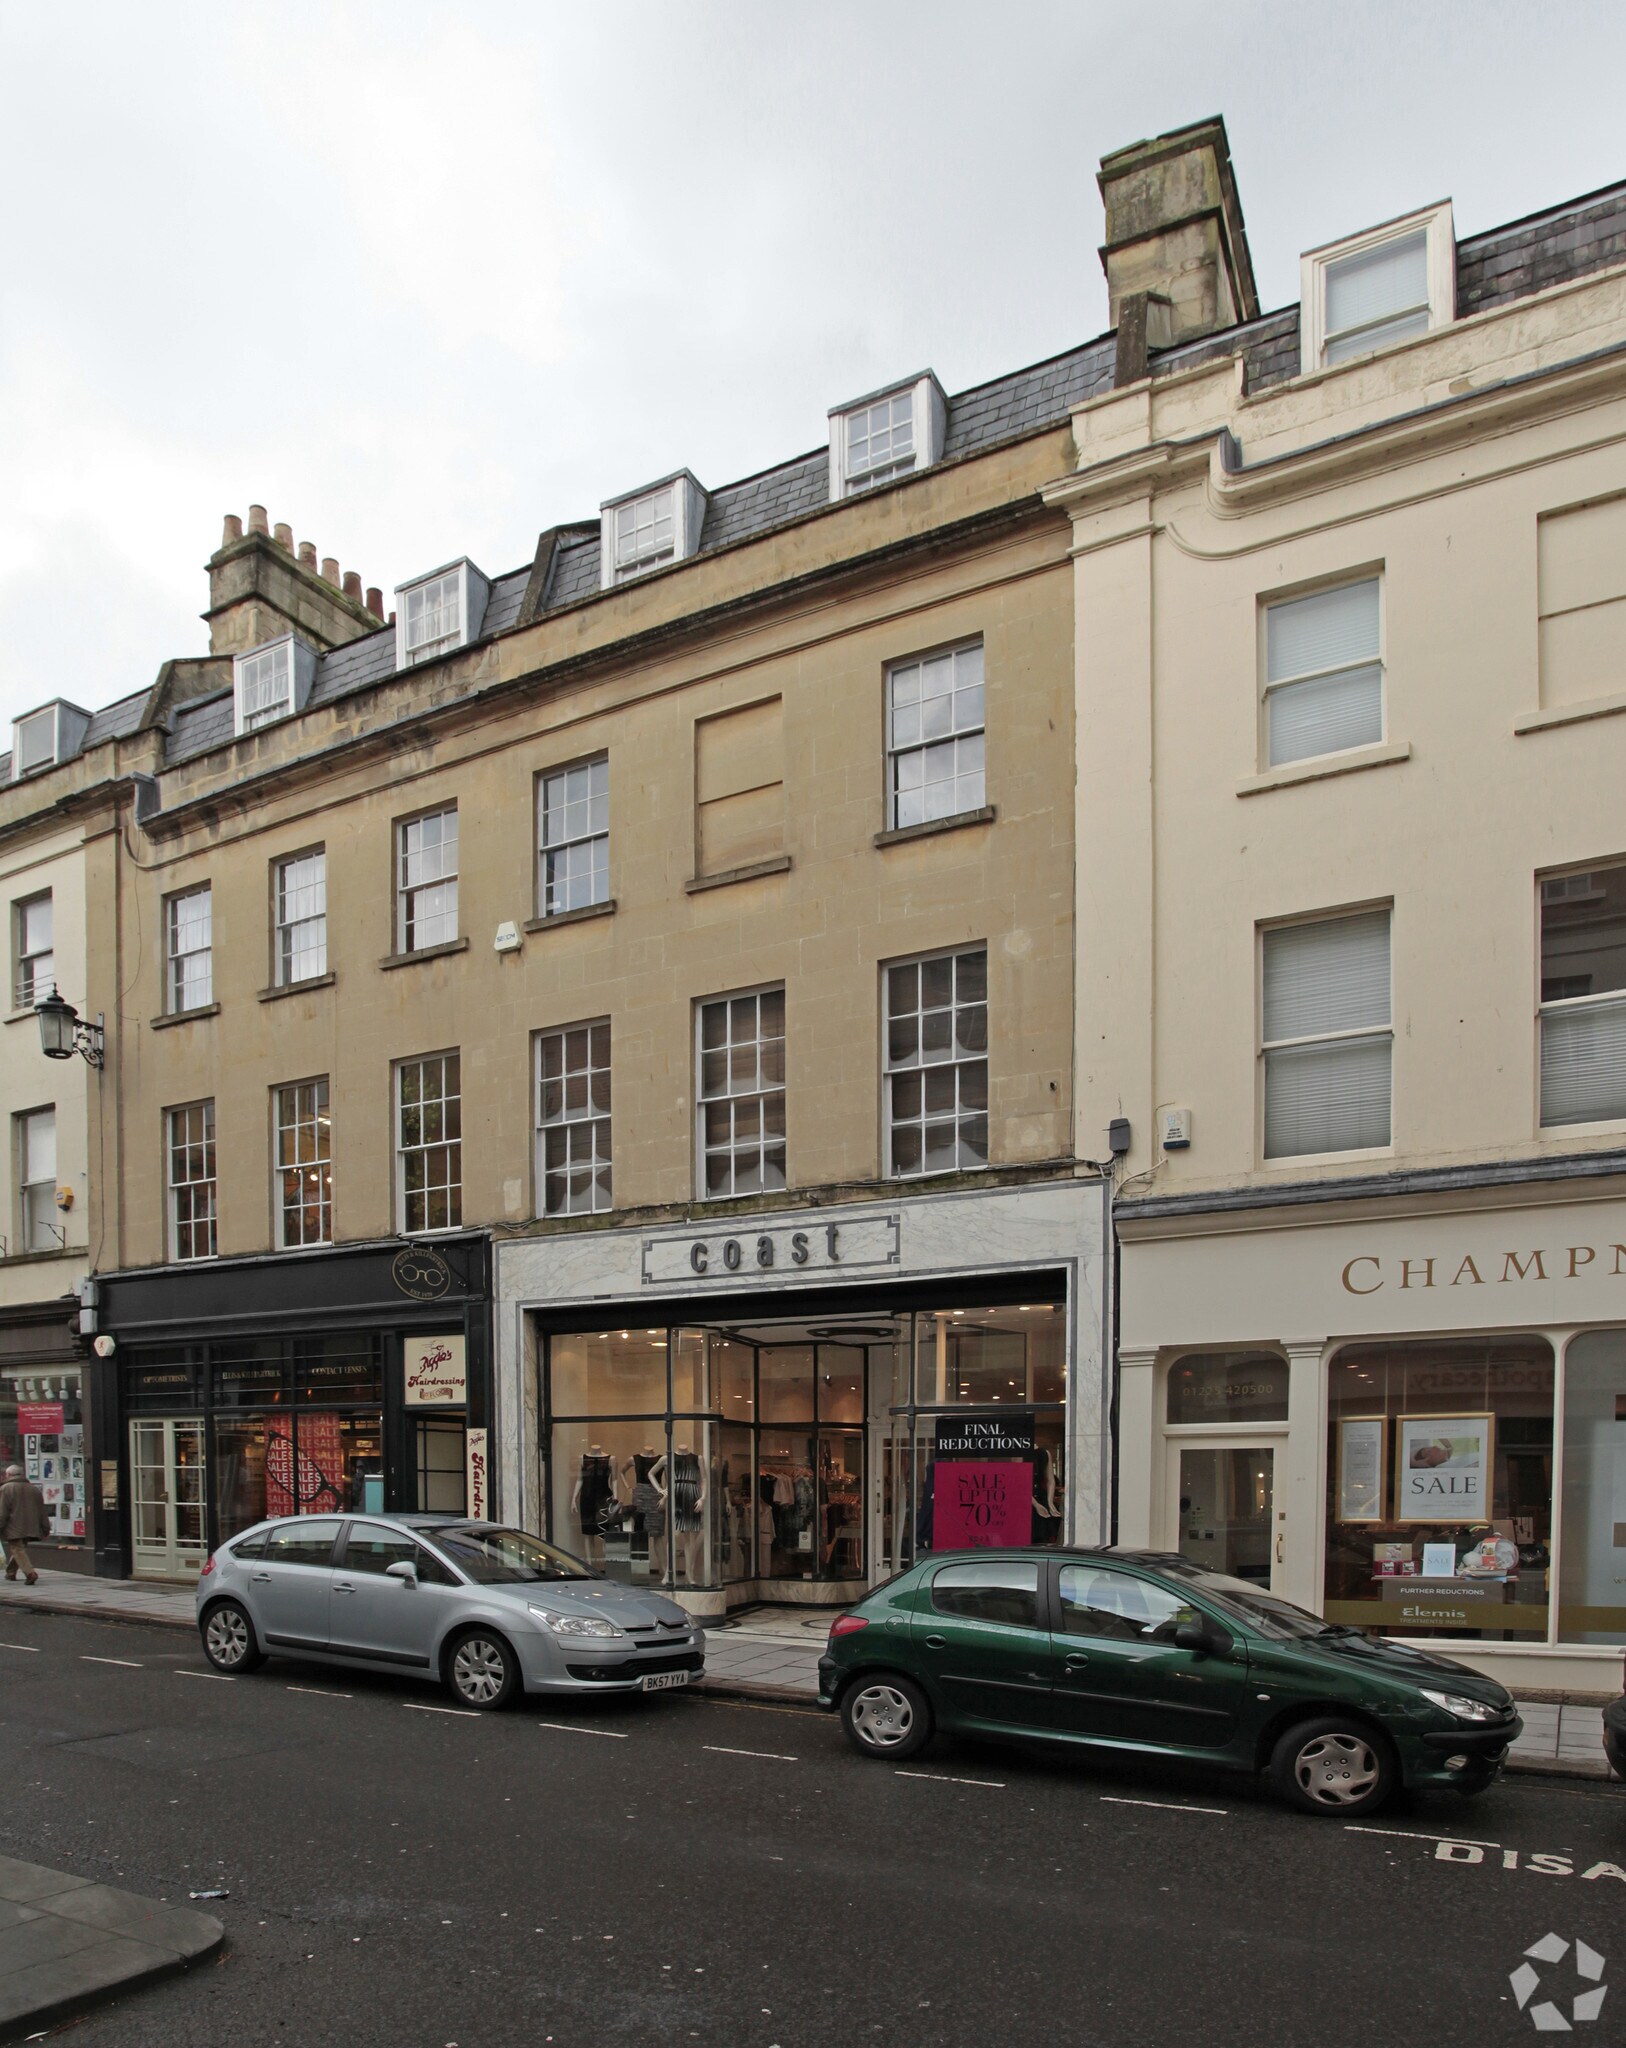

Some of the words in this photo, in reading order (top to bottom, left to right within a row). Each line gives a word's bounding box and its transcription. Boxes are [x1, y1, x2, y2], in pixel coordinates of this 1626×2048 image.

[690, 1222, 839, 1273] coast
[311, 1367, 343, 1376] CONTACT
[344, 1365, 367, 1374] LENSES
[408, 1375, 465, 1387] Hairdressing
[1225, 1384, 1273, 1395] 420500
[965, 1424, 1005, 1435] FINAL
[270, 1440, 287, 1449] ALE
[939, 1438, 1031, 1450] REDUCTIONS
[472, 1452, 485, 1519] Hairdre
[958, 1473, 1006, 1489] SALE
[1411, 1476, 1478, 1495] SALE
[316, 1494, 336, 1504] SAL
[960, 1490, 980, 1502] UP
[982, 1490, 1006, 1502] TO
[1427, 1557, 1449, 1567] SALE
[1400, 1587, 1435, 1595] FURTHER
[1436, 1588, 1485, 1596] REDUCTIONS
[1402, 1605, 1466, 1618] Elemis
[647, 1675, 669, 1689] BK57
[1435, 1841, 1626, 1883] DISA
